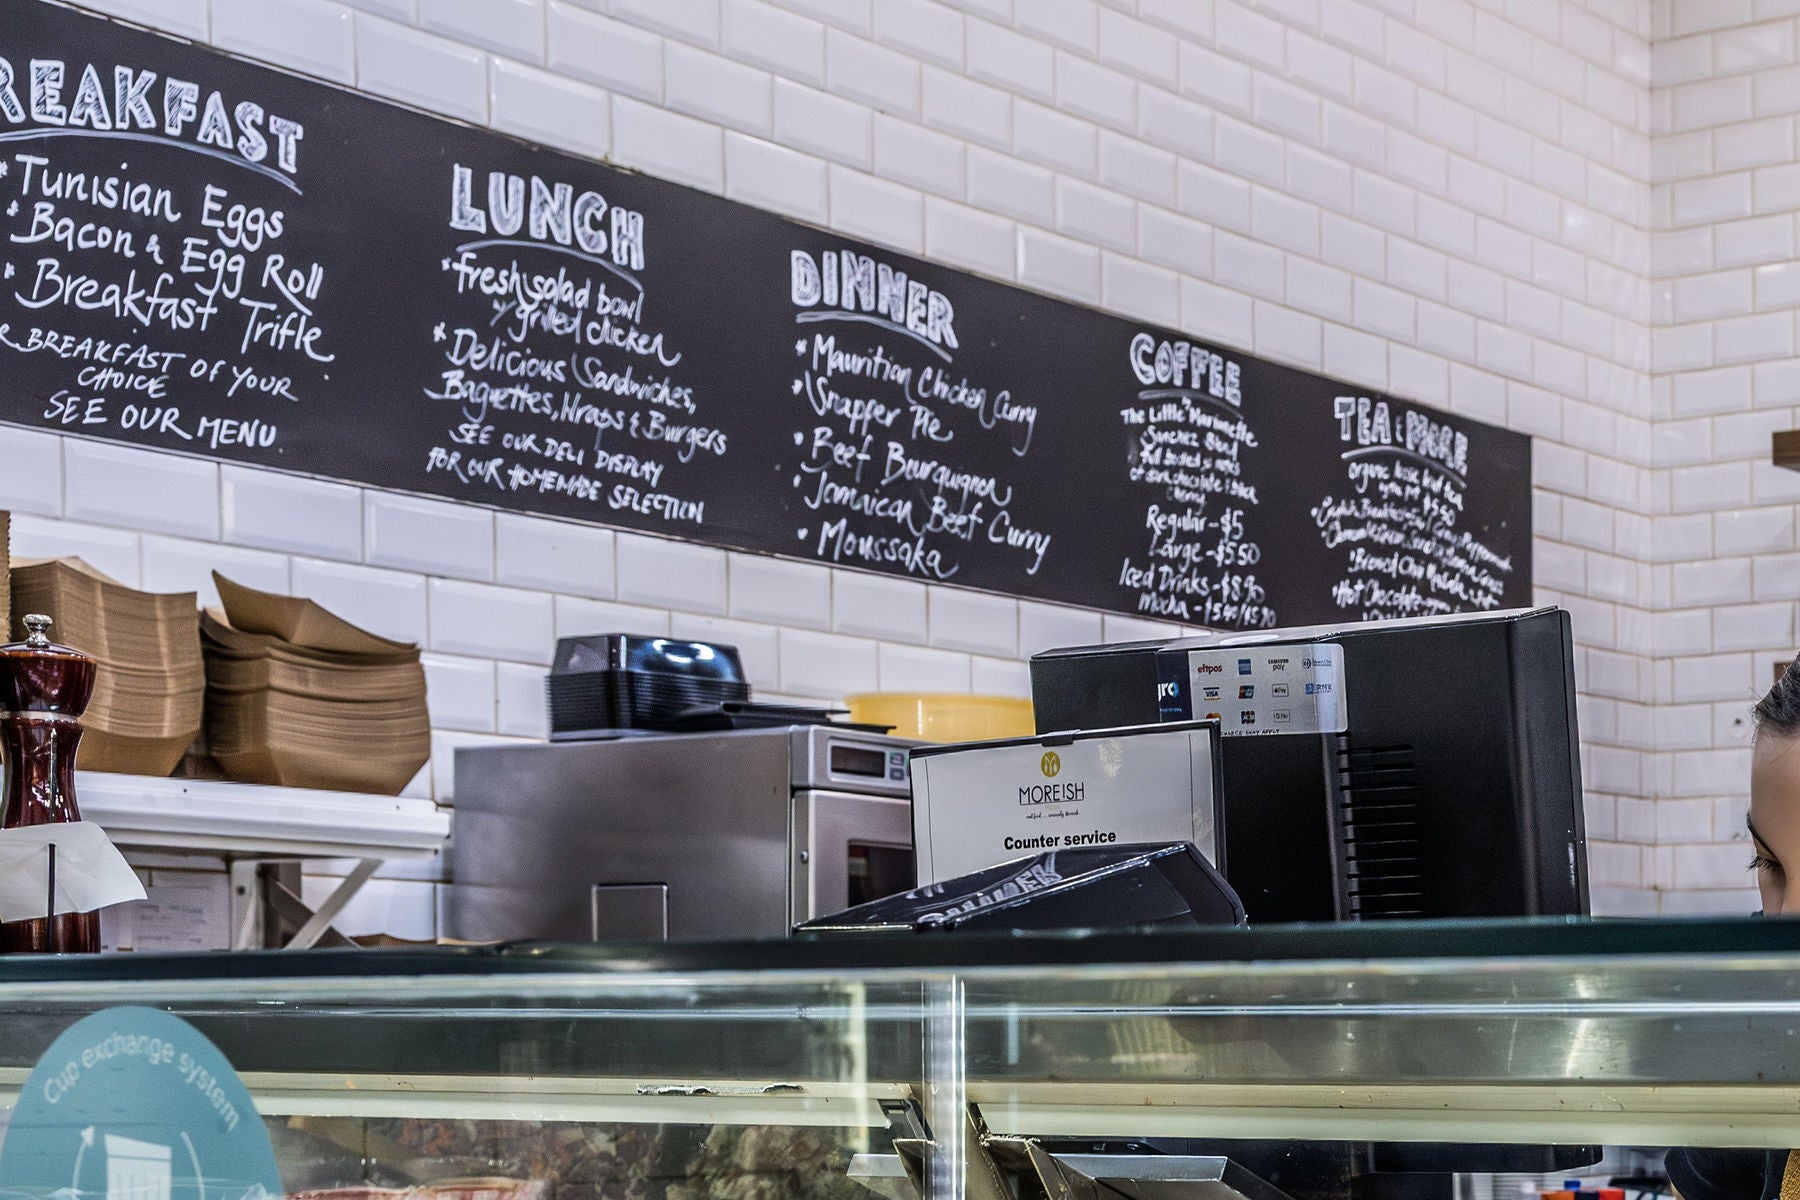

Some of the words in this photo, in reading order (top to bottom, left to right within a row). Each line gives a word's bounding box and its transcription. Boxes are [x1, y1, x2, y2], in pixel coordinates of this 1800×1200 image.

[0, 58, 303, 174] REAKFAST
[15, 154, 181, 223] Tunisian
[201, 184, 284, 251] Eggs
[449, 163, 645, 271] LUNCH
[10, 202, 135, 258] Bacon
[181, 237, 245, 300] Egg
[261, 254, 324, 315] Roll
[15, 258, 217, 330] Breakfast
[239, 297, 335, 361] Trifle
[523, 267, 591, 309] salad
[791, 249, 959, 349] DINNER
[27, 328, 186, 374] BREAKFAST
[228, 365, 298, 402] YOUR
[77, 366, 170, 399] CHOICE
[445, 328, 566, 383] Delicious
[1129, 332, 1242, 408] COFFEE
[43, 390, 108, 425] SEE
[120, 404, 192, 441] OUR
[805, 370, 902, 436] Snapper
[1120, 407, 1146, 425] The
[1334, 397, 1392, 445] TEA
[448, 422, 495, 446] SEE
[502, 432, 544, 454] OUR
[544, 438, 585, 466] DELI
[642, 410, 728, 463] Burgers
[800, 426, 874, 483] Beef
[425, 446, 470, 484] FOR
[468, 456, 506, 490] OUR
[817, 517, 960, 580] Moussaka
[926, 494, 984, 541] Beef
[988, 511, 1051, 575] Curry
[1146, 504, 1207, 543] Regular
[1119, 557, 1155, 589] Iced
[1158, 565, 1210, 596] Drinks
[1149, 533, 1203, 573] Large
[1197, 663, 1223, 675] eftpos
[1019, 782, 1085, 805] MOREISH
[1004, 834, 1060, 850] Counter
[1064, 830, 1116, 846] service
[43, 1060, 80, 1105] Cup
[82, 1031, 175, 1069] exchange
[179, 1053, 242, 1131] system
